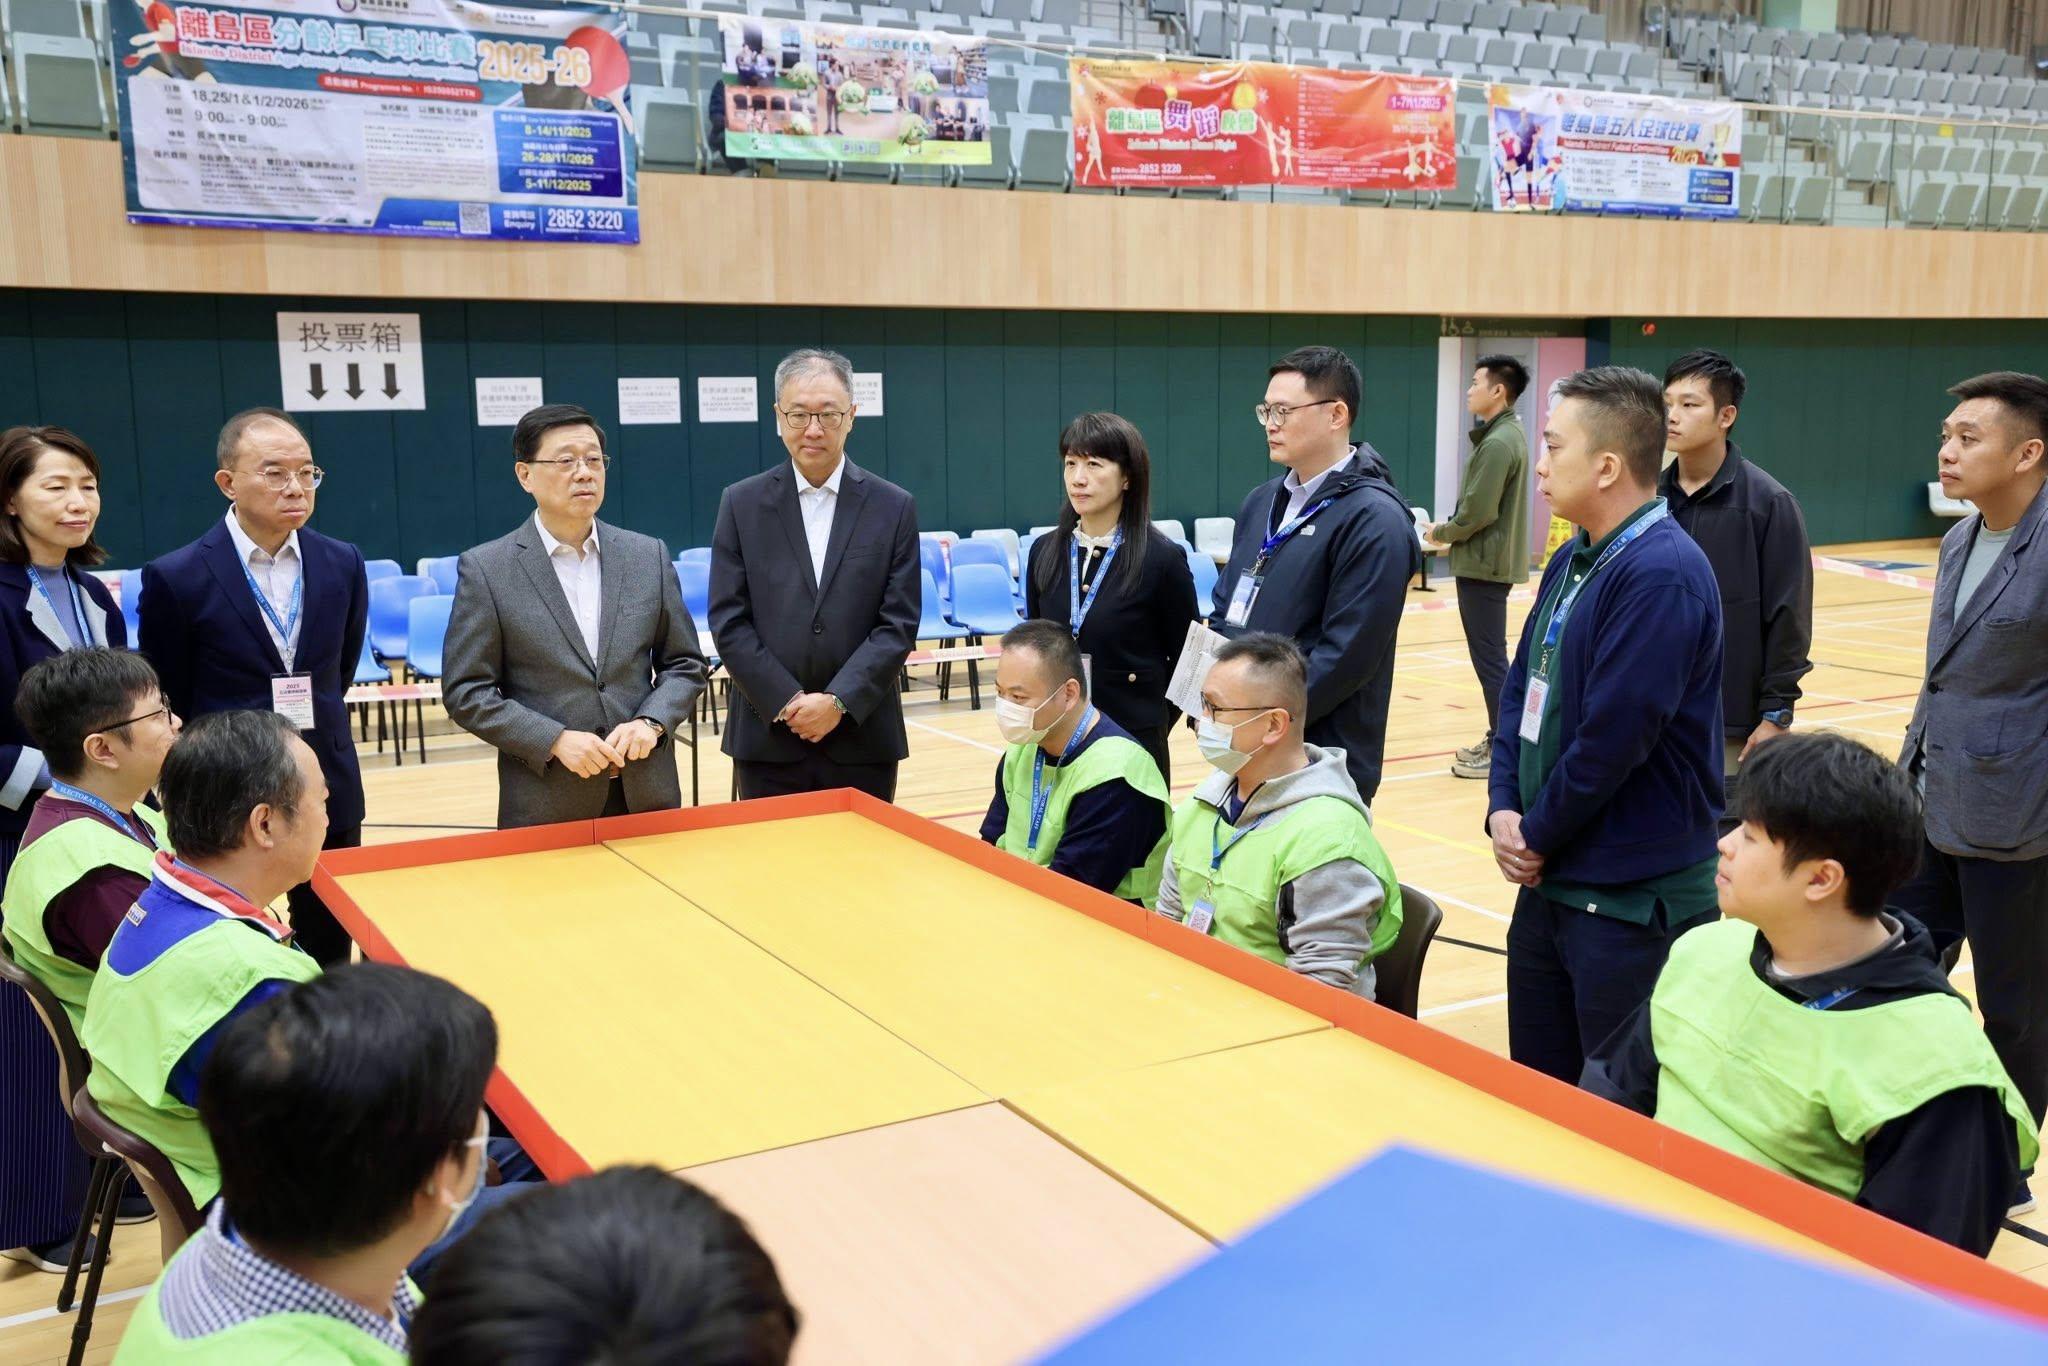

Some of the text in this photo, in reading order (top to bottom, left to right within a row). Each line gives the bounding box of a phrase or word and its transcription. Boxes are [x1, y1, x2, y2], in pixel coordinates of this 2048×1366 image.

[228, 49, 273, 62] District
[480, 41, 591, 86] 2025-26
[547, 208, 585, 228] 2852
[587, 211, 623, 230] 3220
[299, 321, 401, 353] 投票箱
[59, 786, 118, 819] ELECTORAL STAFF
